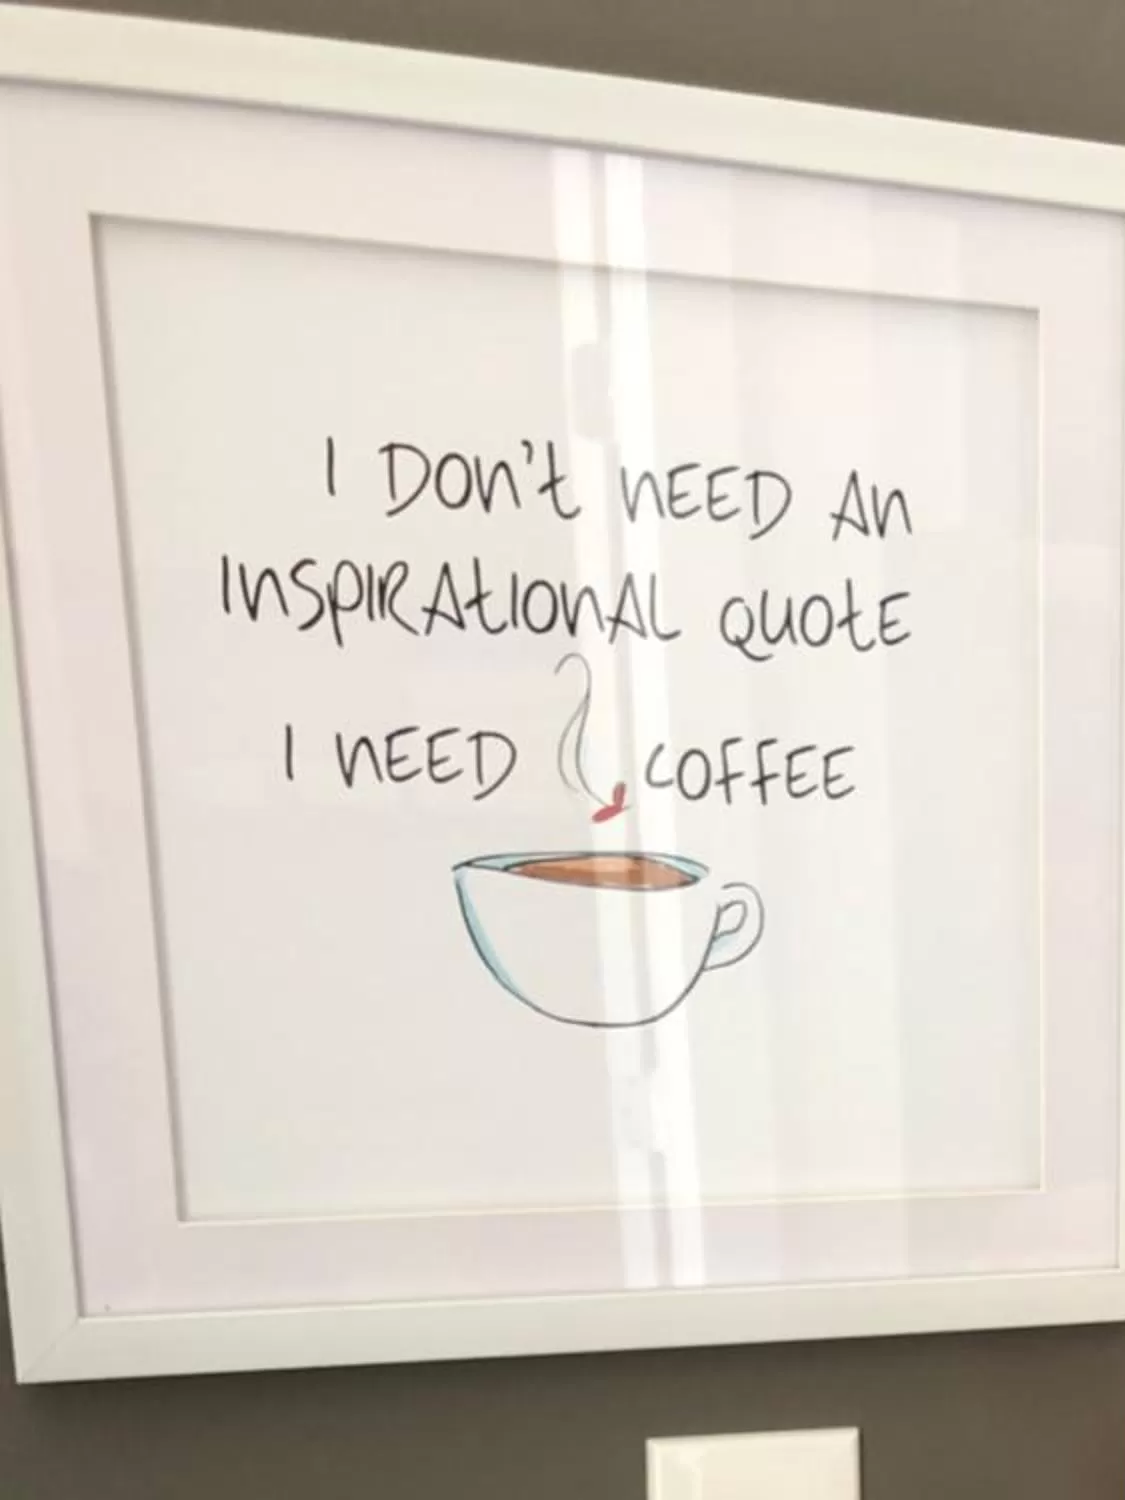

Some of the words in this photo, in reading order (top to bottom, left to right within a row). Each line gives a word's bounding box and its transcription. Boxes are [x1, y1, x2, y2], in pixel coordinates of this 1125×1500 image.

[325, 436, 336, 496] I
[284, 723, 295, 782] I
[645, 737, 855, 805] COFFEE
